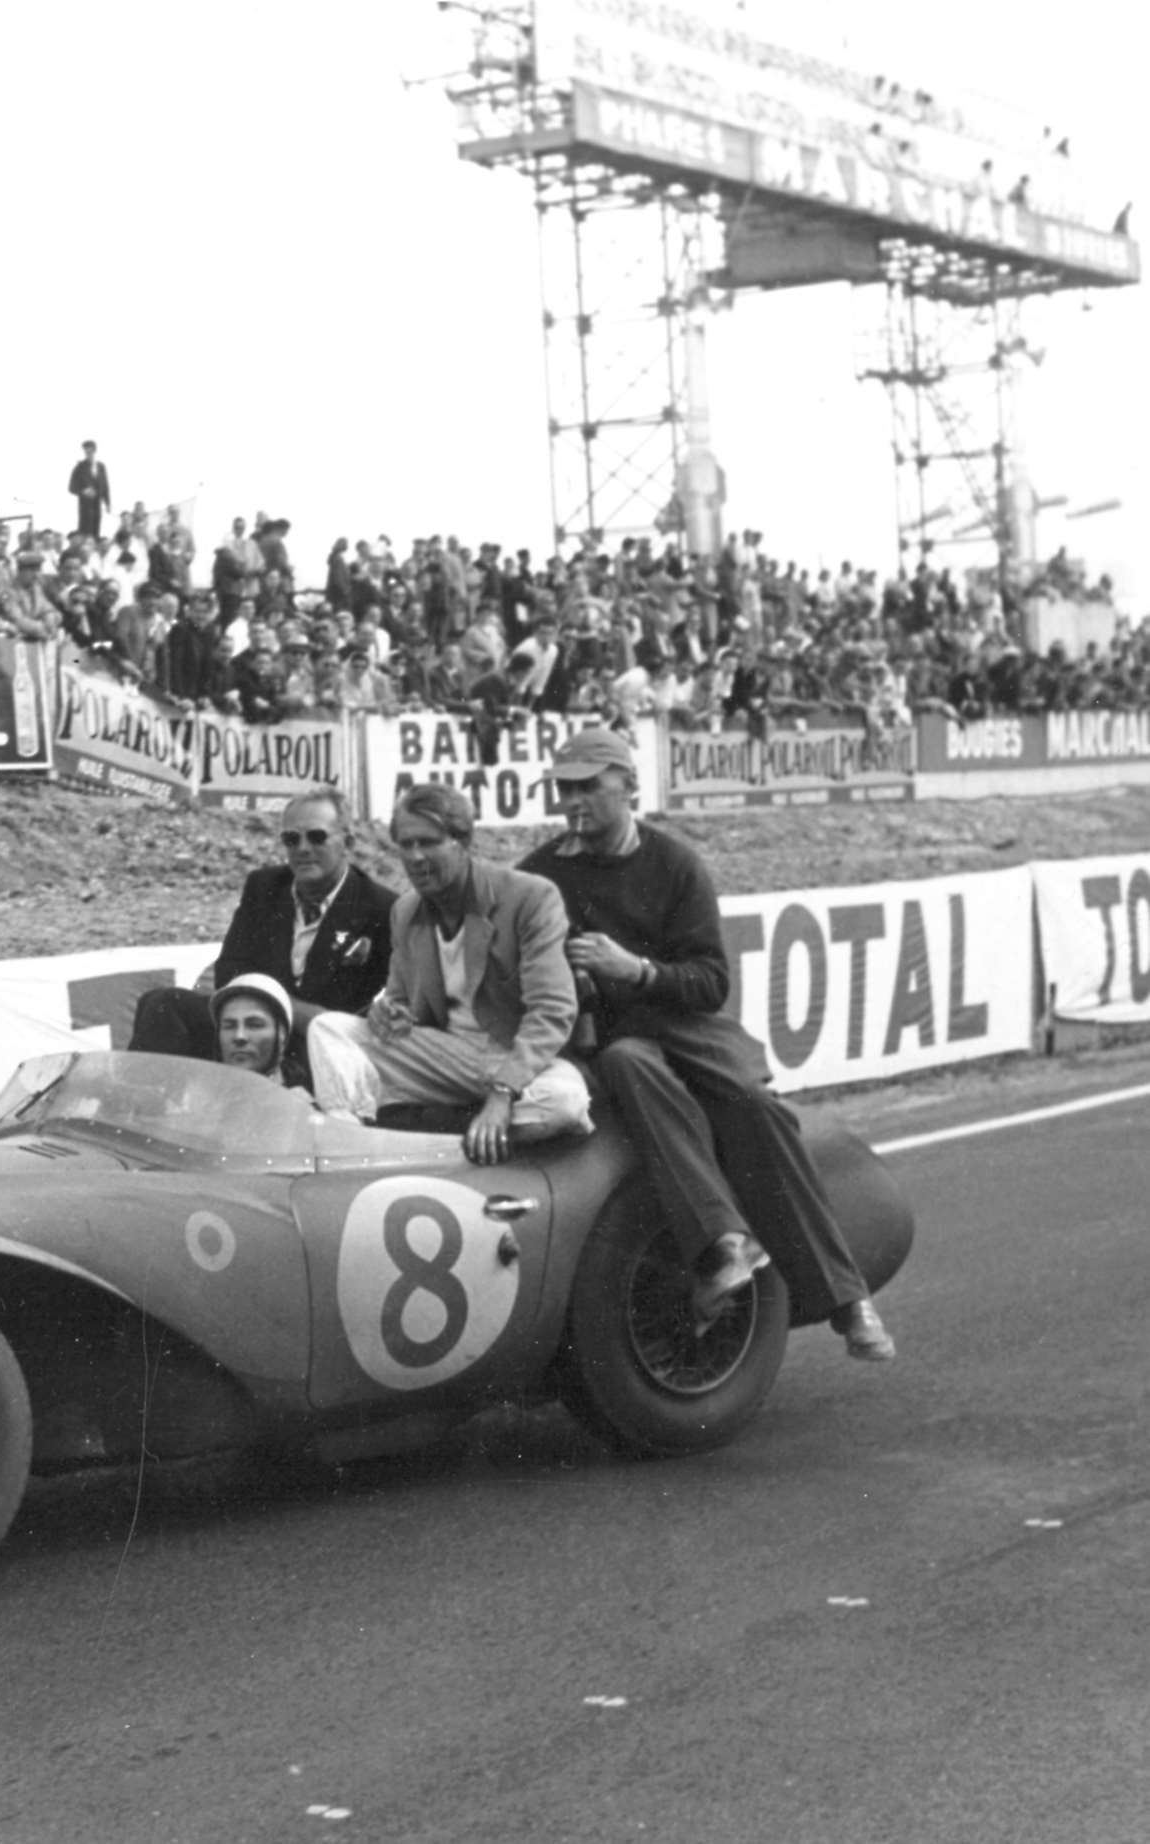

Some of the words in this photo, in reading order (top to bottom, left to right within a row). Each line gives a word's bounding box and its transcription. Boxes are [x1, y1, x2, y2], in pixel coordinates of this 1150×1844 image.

[200, 721, 339, 786] POLAROIL
[670, 737, 756, 789] POLAROIL
[719, 893, 988, 1070] TOTAL
[380, 1194, 469, 1369] 8
